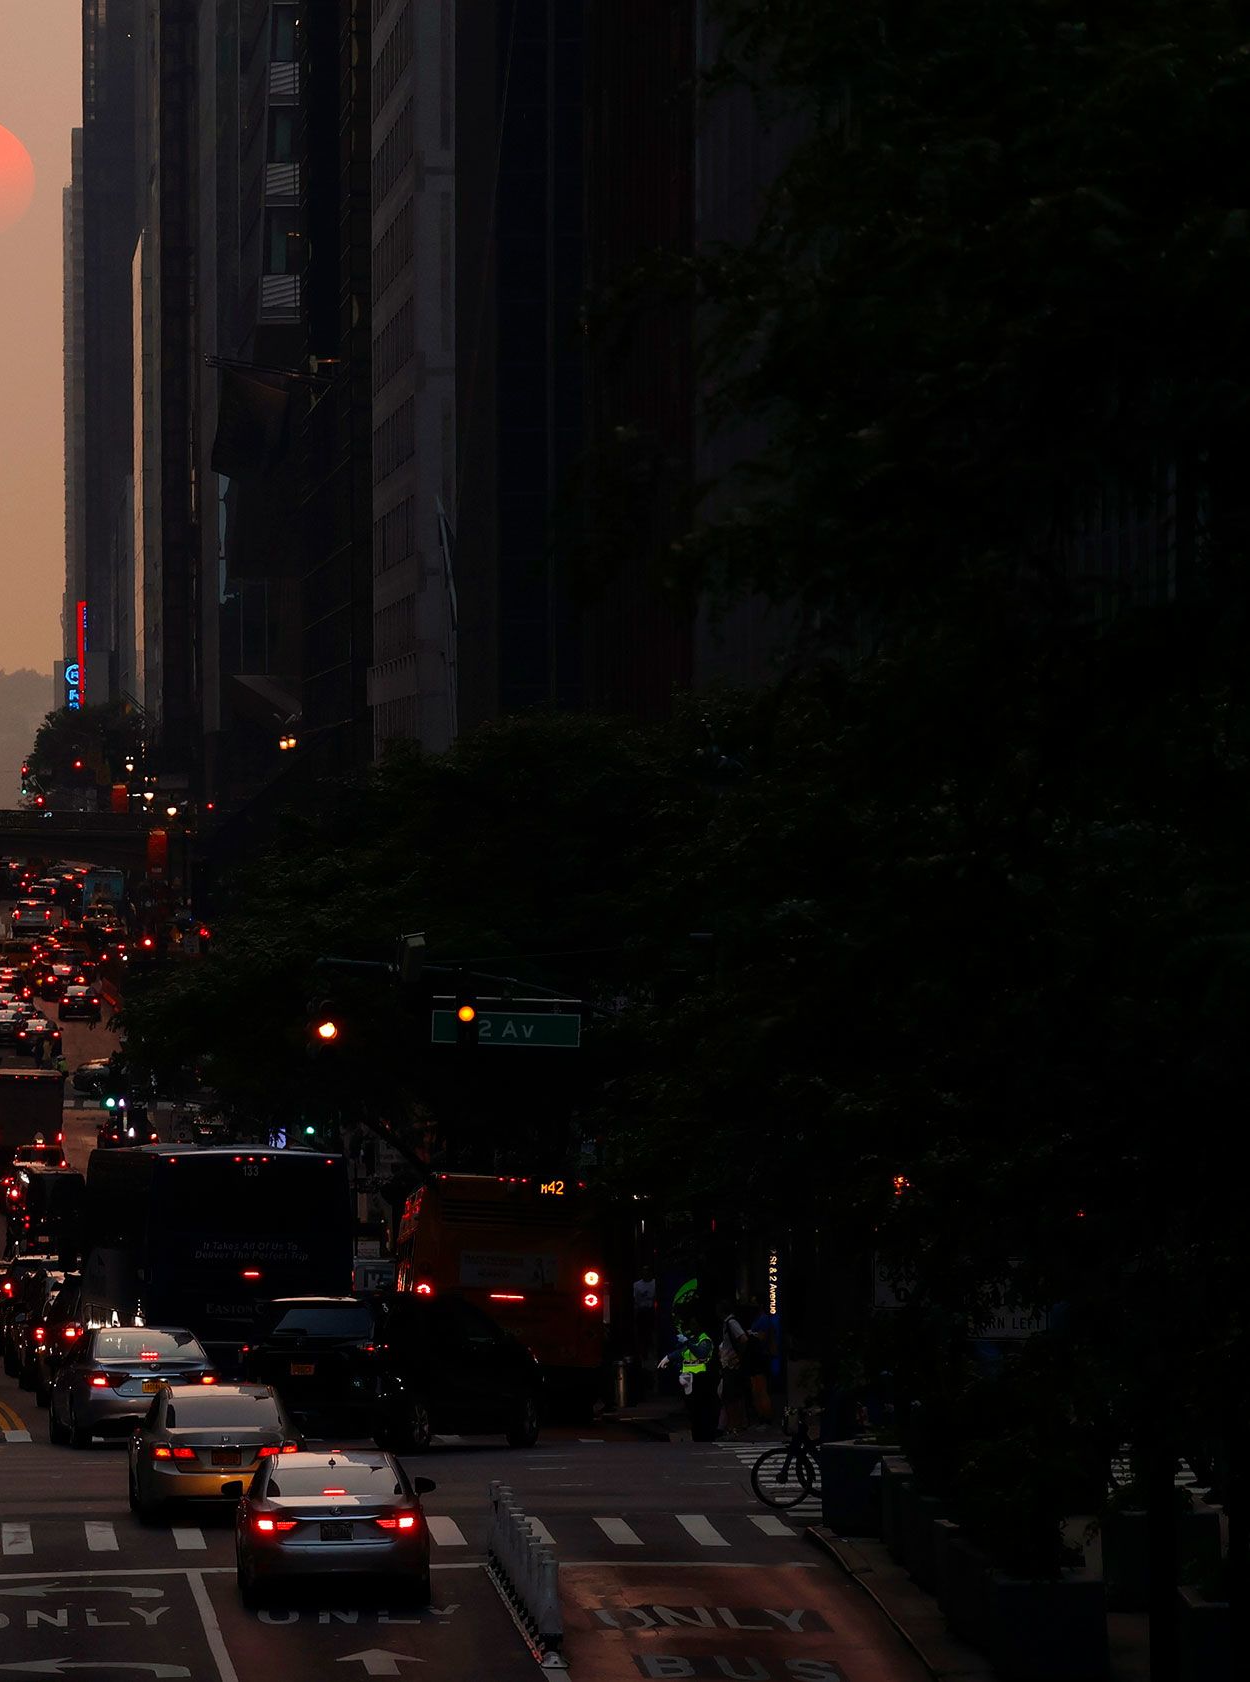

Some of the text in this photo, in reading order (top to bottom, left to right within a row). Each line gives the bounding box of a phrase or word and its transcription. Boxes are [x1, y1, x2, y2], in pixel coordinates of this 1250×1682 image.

[477, 1019, 535, 1039] 2 Av
[540, 1180, 565, 1195] M42
[232, 1250, 251, 1260] The
[769, 1255, 778, 1265] St
[592, 1605, 806, 1633] ONLY
[638, 1654, 842, 1682] BUS
